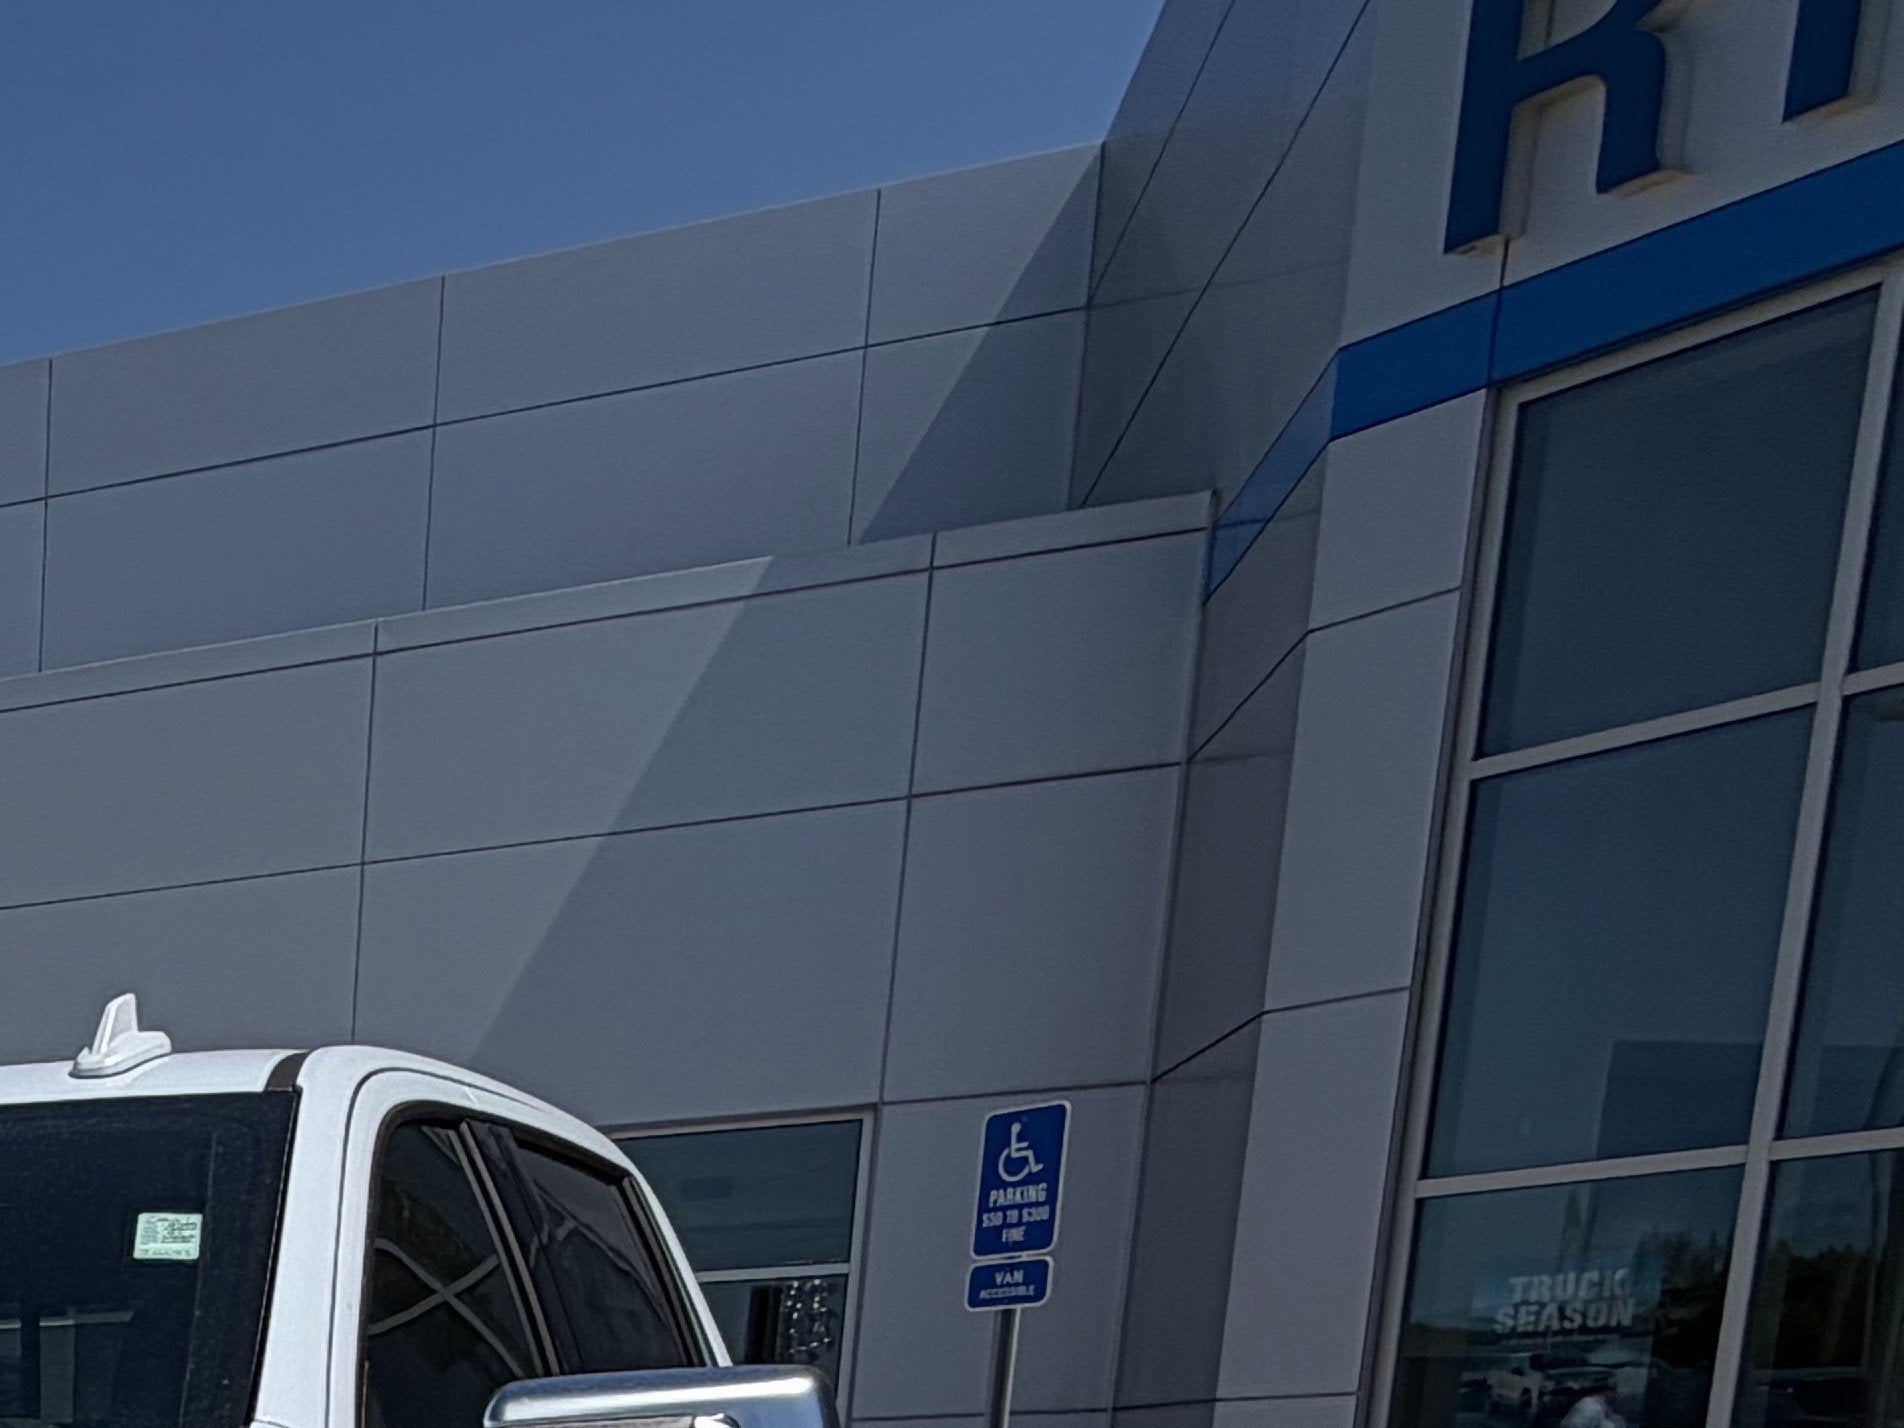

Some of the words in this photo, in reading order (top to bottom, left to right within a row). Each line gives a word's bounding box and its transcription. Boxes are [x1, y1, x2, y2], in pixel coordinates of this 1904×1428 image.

[989, 1183, 1048, 1208] PARKING
[982, 1211, 1004, 1228] $50
[1006, 1208, 1020, 1224] TO
[1002, 1227, 1026, 1243] FINE
[994, 1270, 1024, 1286] VAN
[1508, 1268, 1630, 1302] TRUCK
[1494, 1298, 1634, 1334] SEASON
